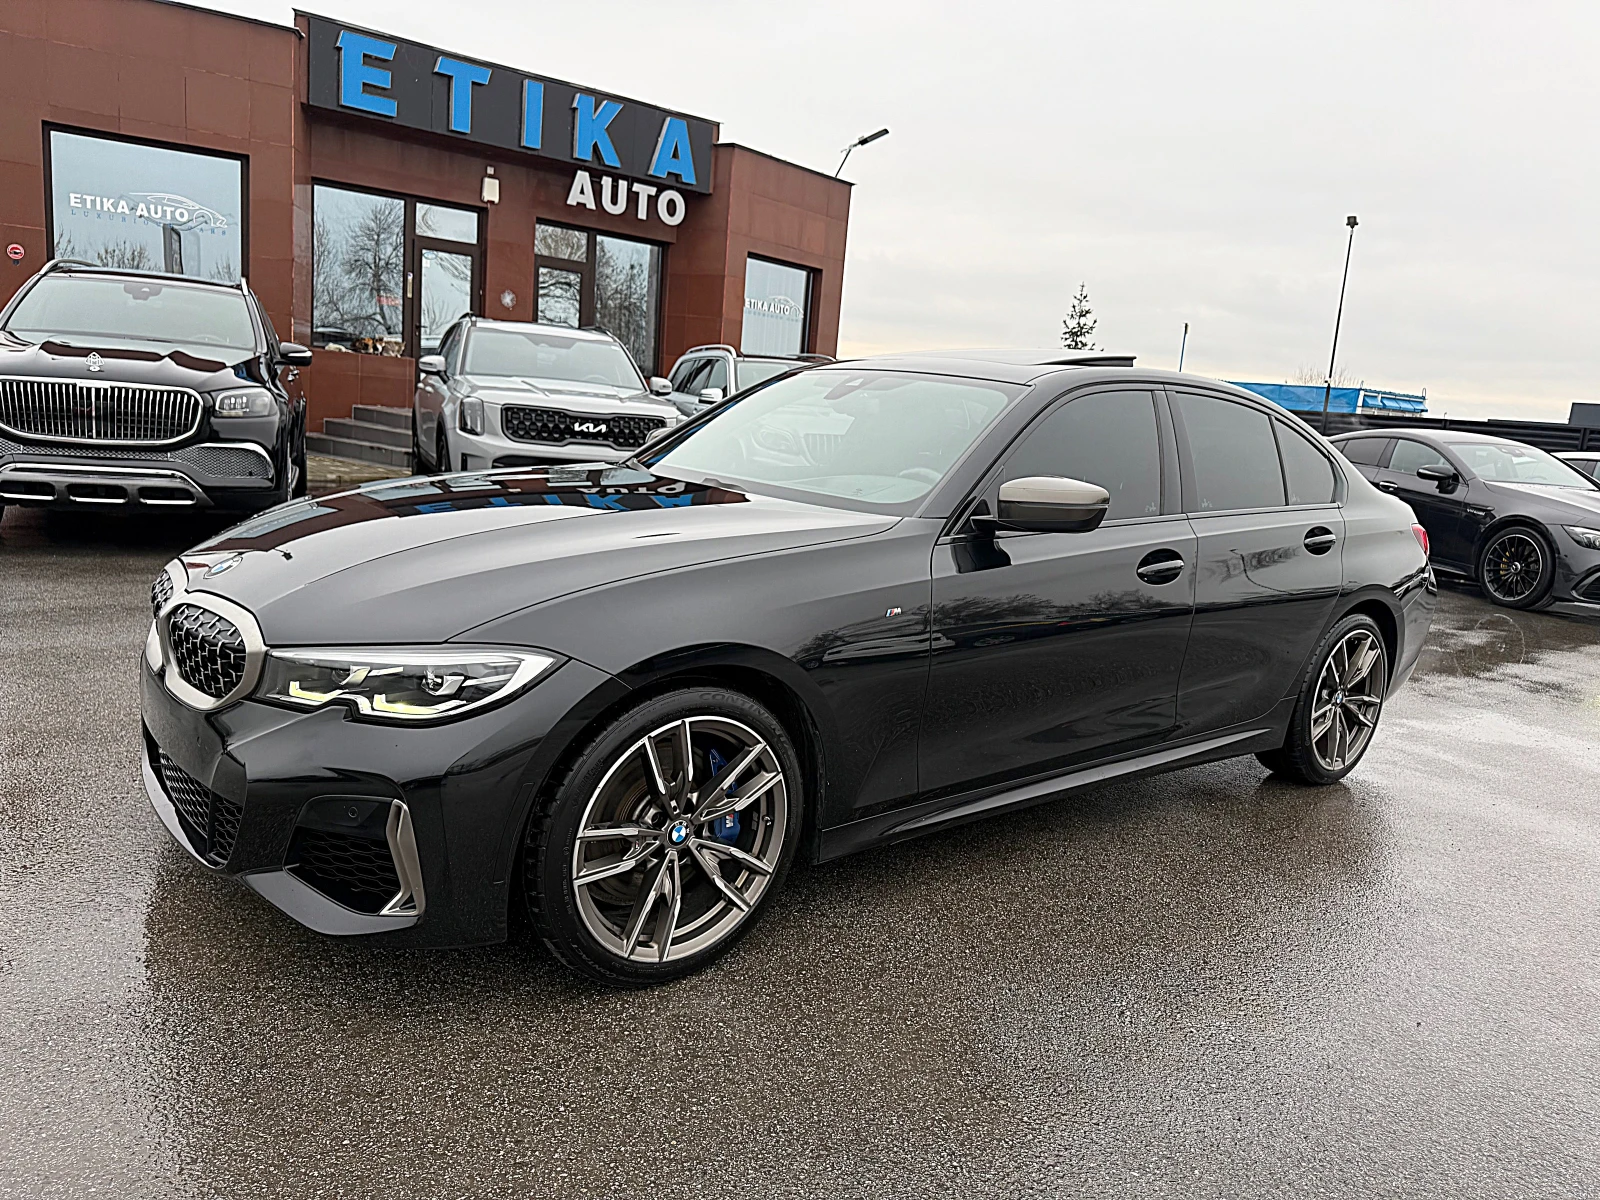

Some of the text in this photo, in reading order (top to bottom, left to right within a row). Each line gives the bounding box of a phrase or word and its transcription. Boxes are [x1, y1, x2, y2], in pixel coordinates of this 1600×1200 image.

[336, 29, 697, 185] ETIKA
[69, 193, 189, 222] ETIKA AUTO
[566, 170, 686, 226] AUTO
[745, 299, 790, 315] ETIKA AUTO
[574, 422, 607, 433] KIA
